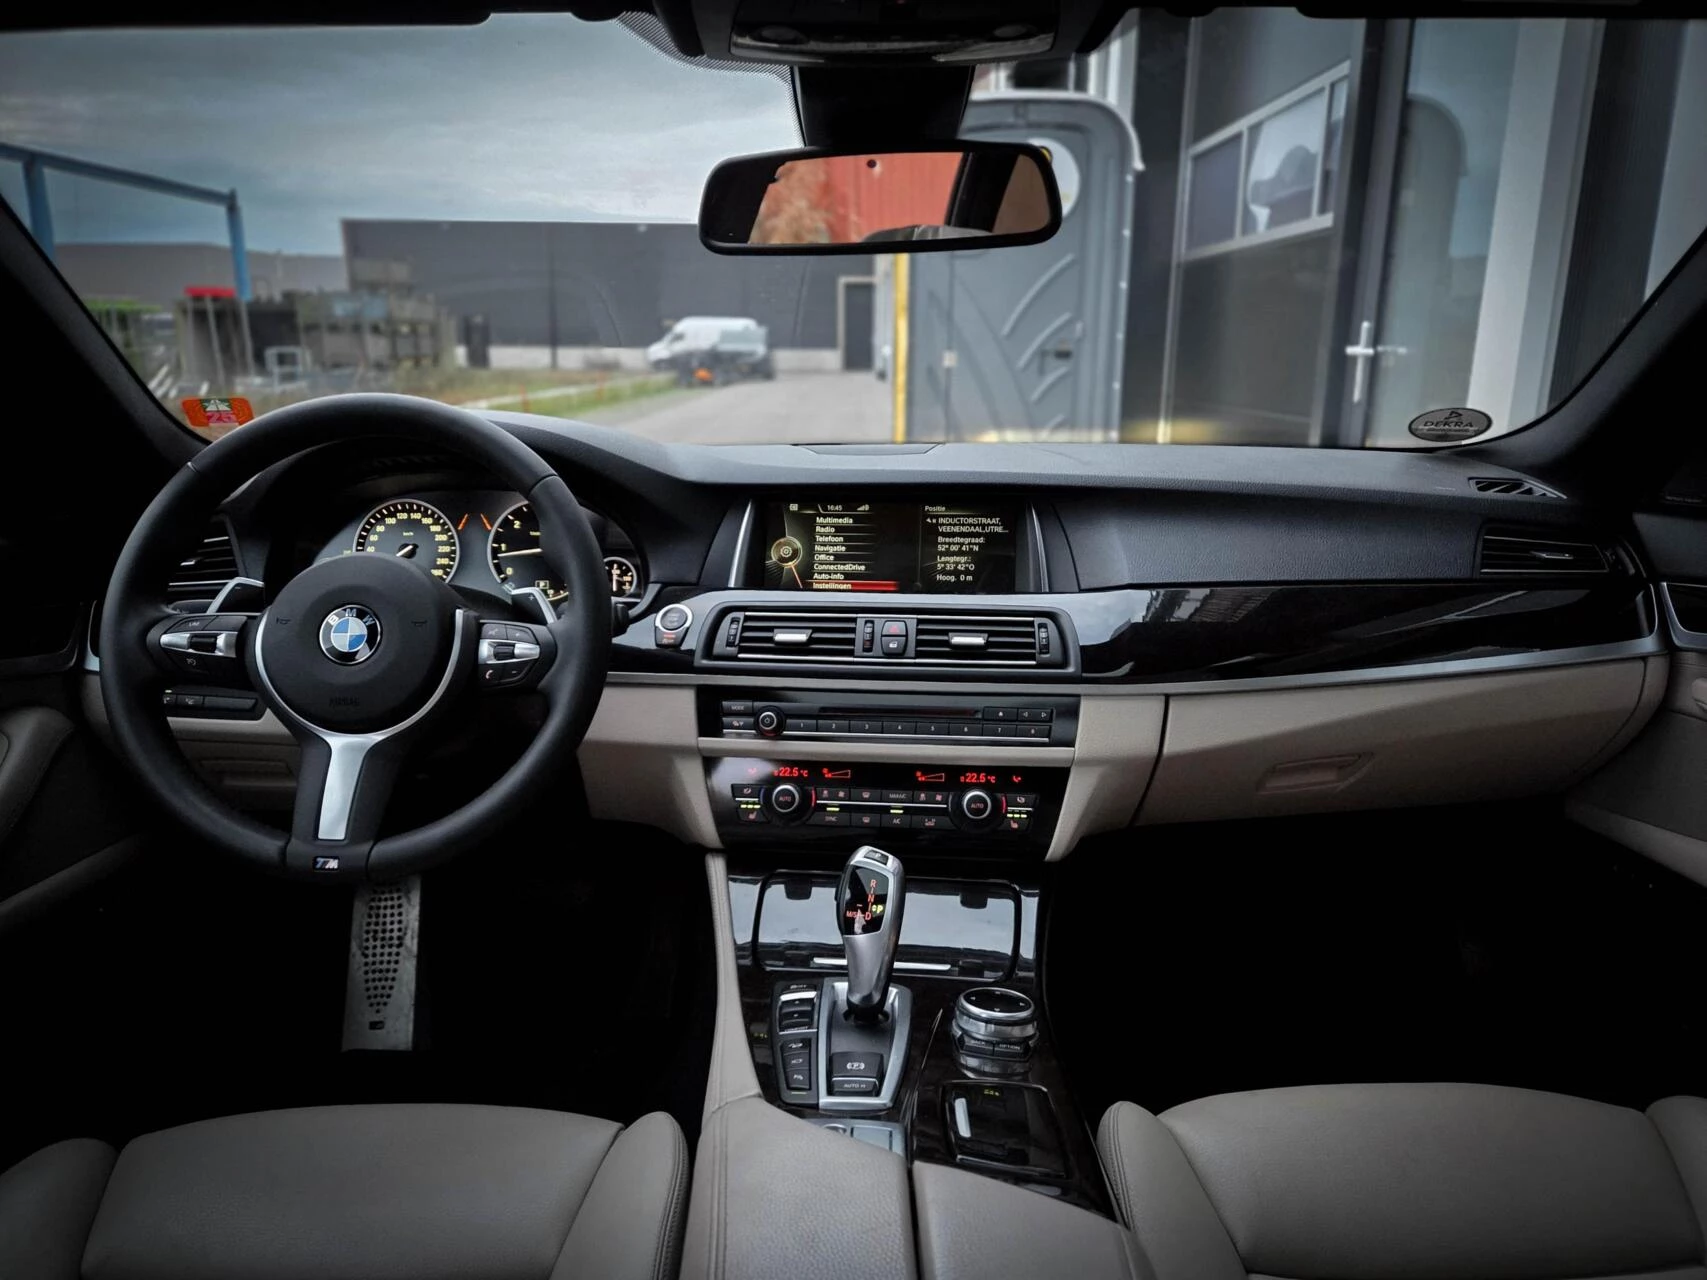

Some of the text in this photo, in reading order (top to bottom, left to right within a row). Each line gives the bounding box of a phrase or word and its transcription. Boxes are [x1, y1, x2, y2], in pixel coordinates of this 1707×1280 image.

[410, 512, 422, 520] 140
[421, 517, 433, 525] 160
[513, 520, 521, 529] 2
[938, 517, 1001, 525] INDUCTORSTRAAT,
[937, 536, 986, 544] Breedtegraad:
[500, 543, 507, 551] 1
[814, 545, 846, 553] Navigatie
[506, 567, 513, 575] 0
[936, 574, 957, 582] Hoog.
[812, 582, 852, 591] Instellingen
[327, 608, 376, 626] BMW
[870, 879, 877, 888] R
[867, 894, 875, 903] N
[865, 911, 872, 920] D
